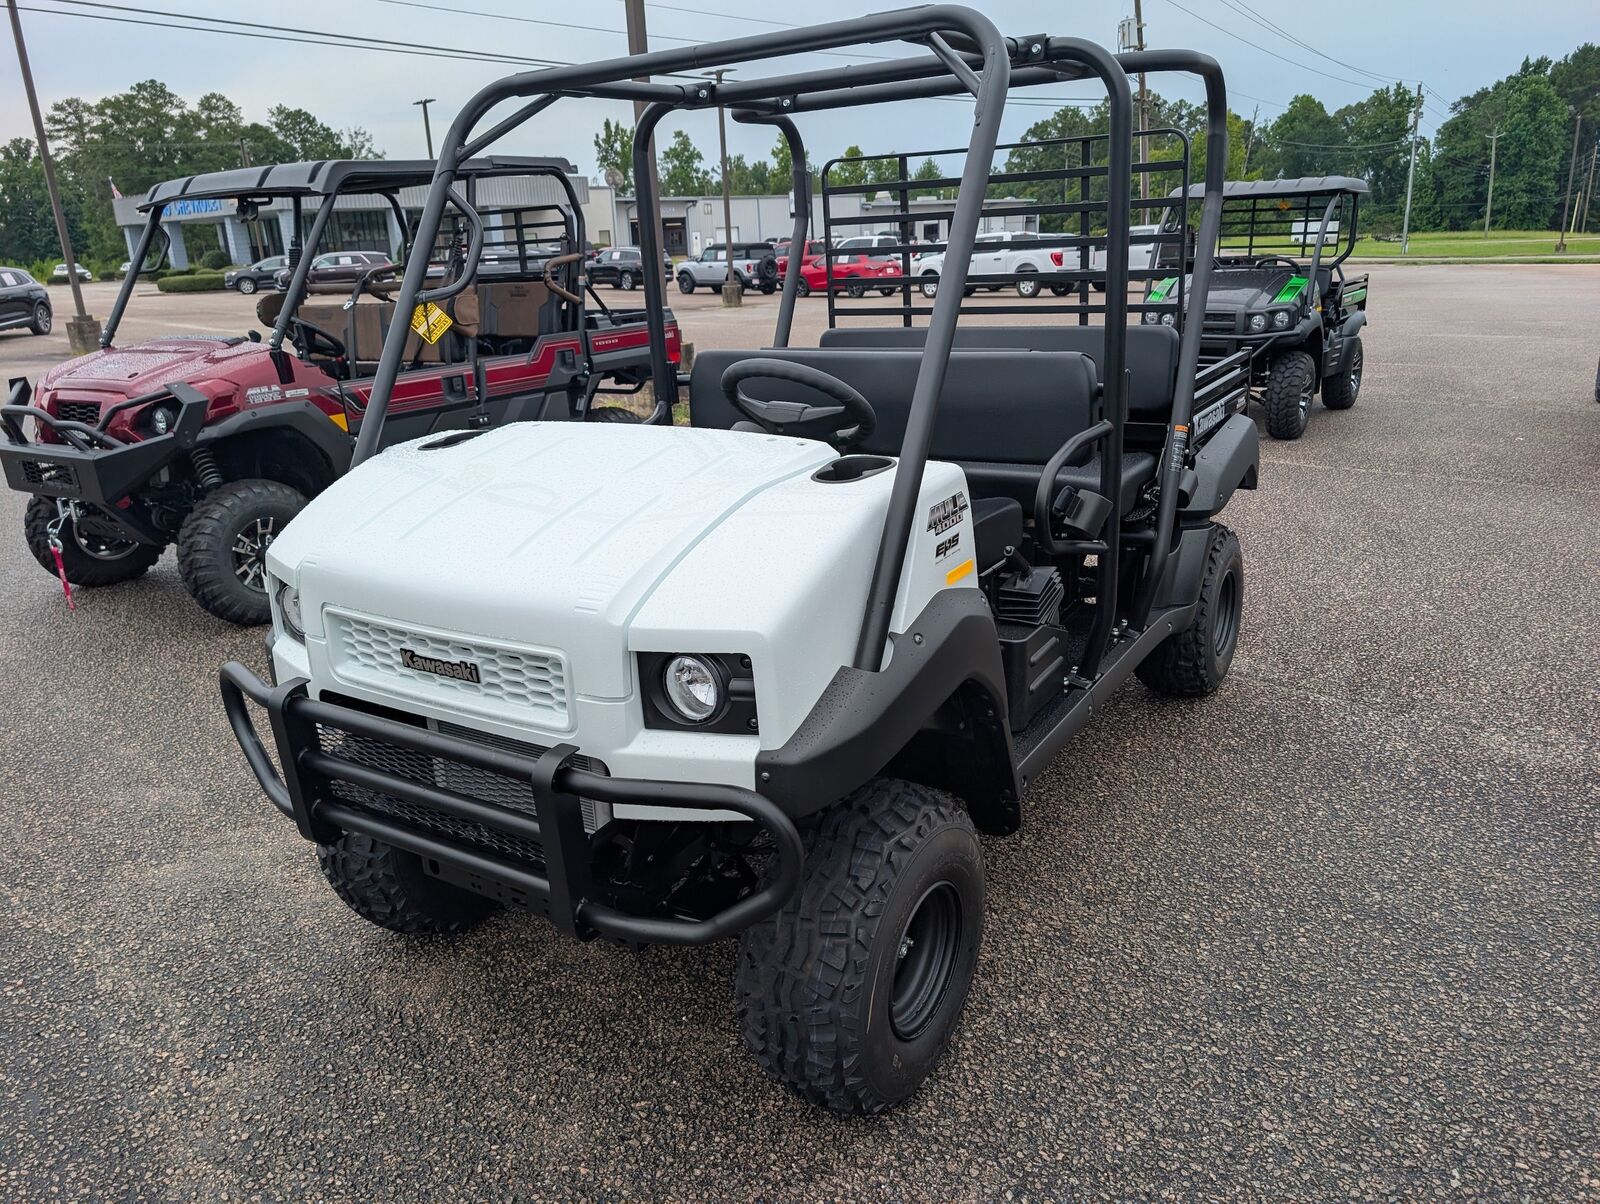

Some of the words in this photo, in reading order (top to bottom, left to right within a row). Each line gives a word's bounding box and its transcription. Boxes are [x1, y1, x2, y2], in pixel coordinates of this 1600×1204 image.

[1193, 401, 1225, 437] Kawasaki
[926, 491, 969, 532] MULE
[935, 512, 964, 536] 4000
[935, 532, 960, 558] EPS
[399, 647, 481, 684] Kawasaki
